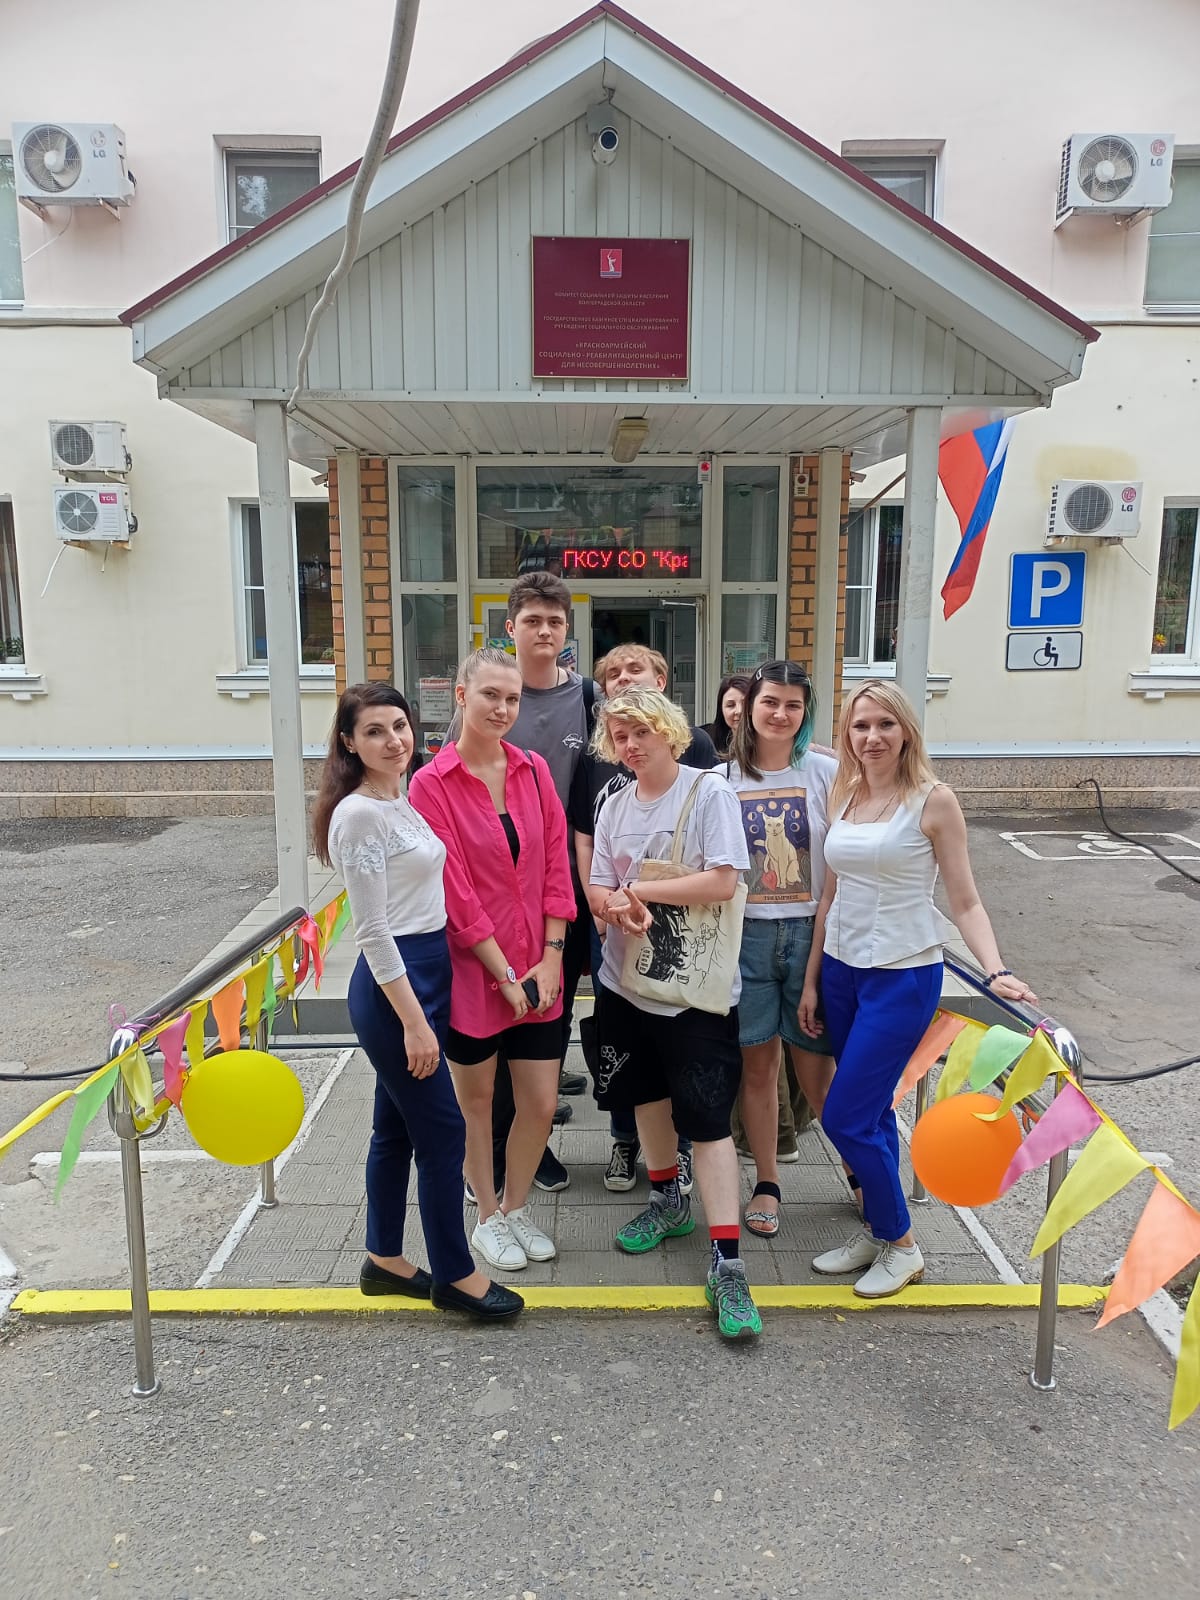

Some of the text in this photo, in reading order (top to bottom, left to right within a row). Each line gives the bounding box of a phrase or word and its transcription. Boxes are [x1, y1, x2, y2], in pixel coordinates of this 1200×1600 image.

[93, 149, 106, 158] LG
[1150, 158, 1163, 167] LG
[561, 361, 576, 369] ДЛЯ
[1121, 504, 1134, 512] LG
[563, 551, 613, 569] ГКСУ
[618, 551, 647, 569] СО
[1030, 561, 1071, 618] P
